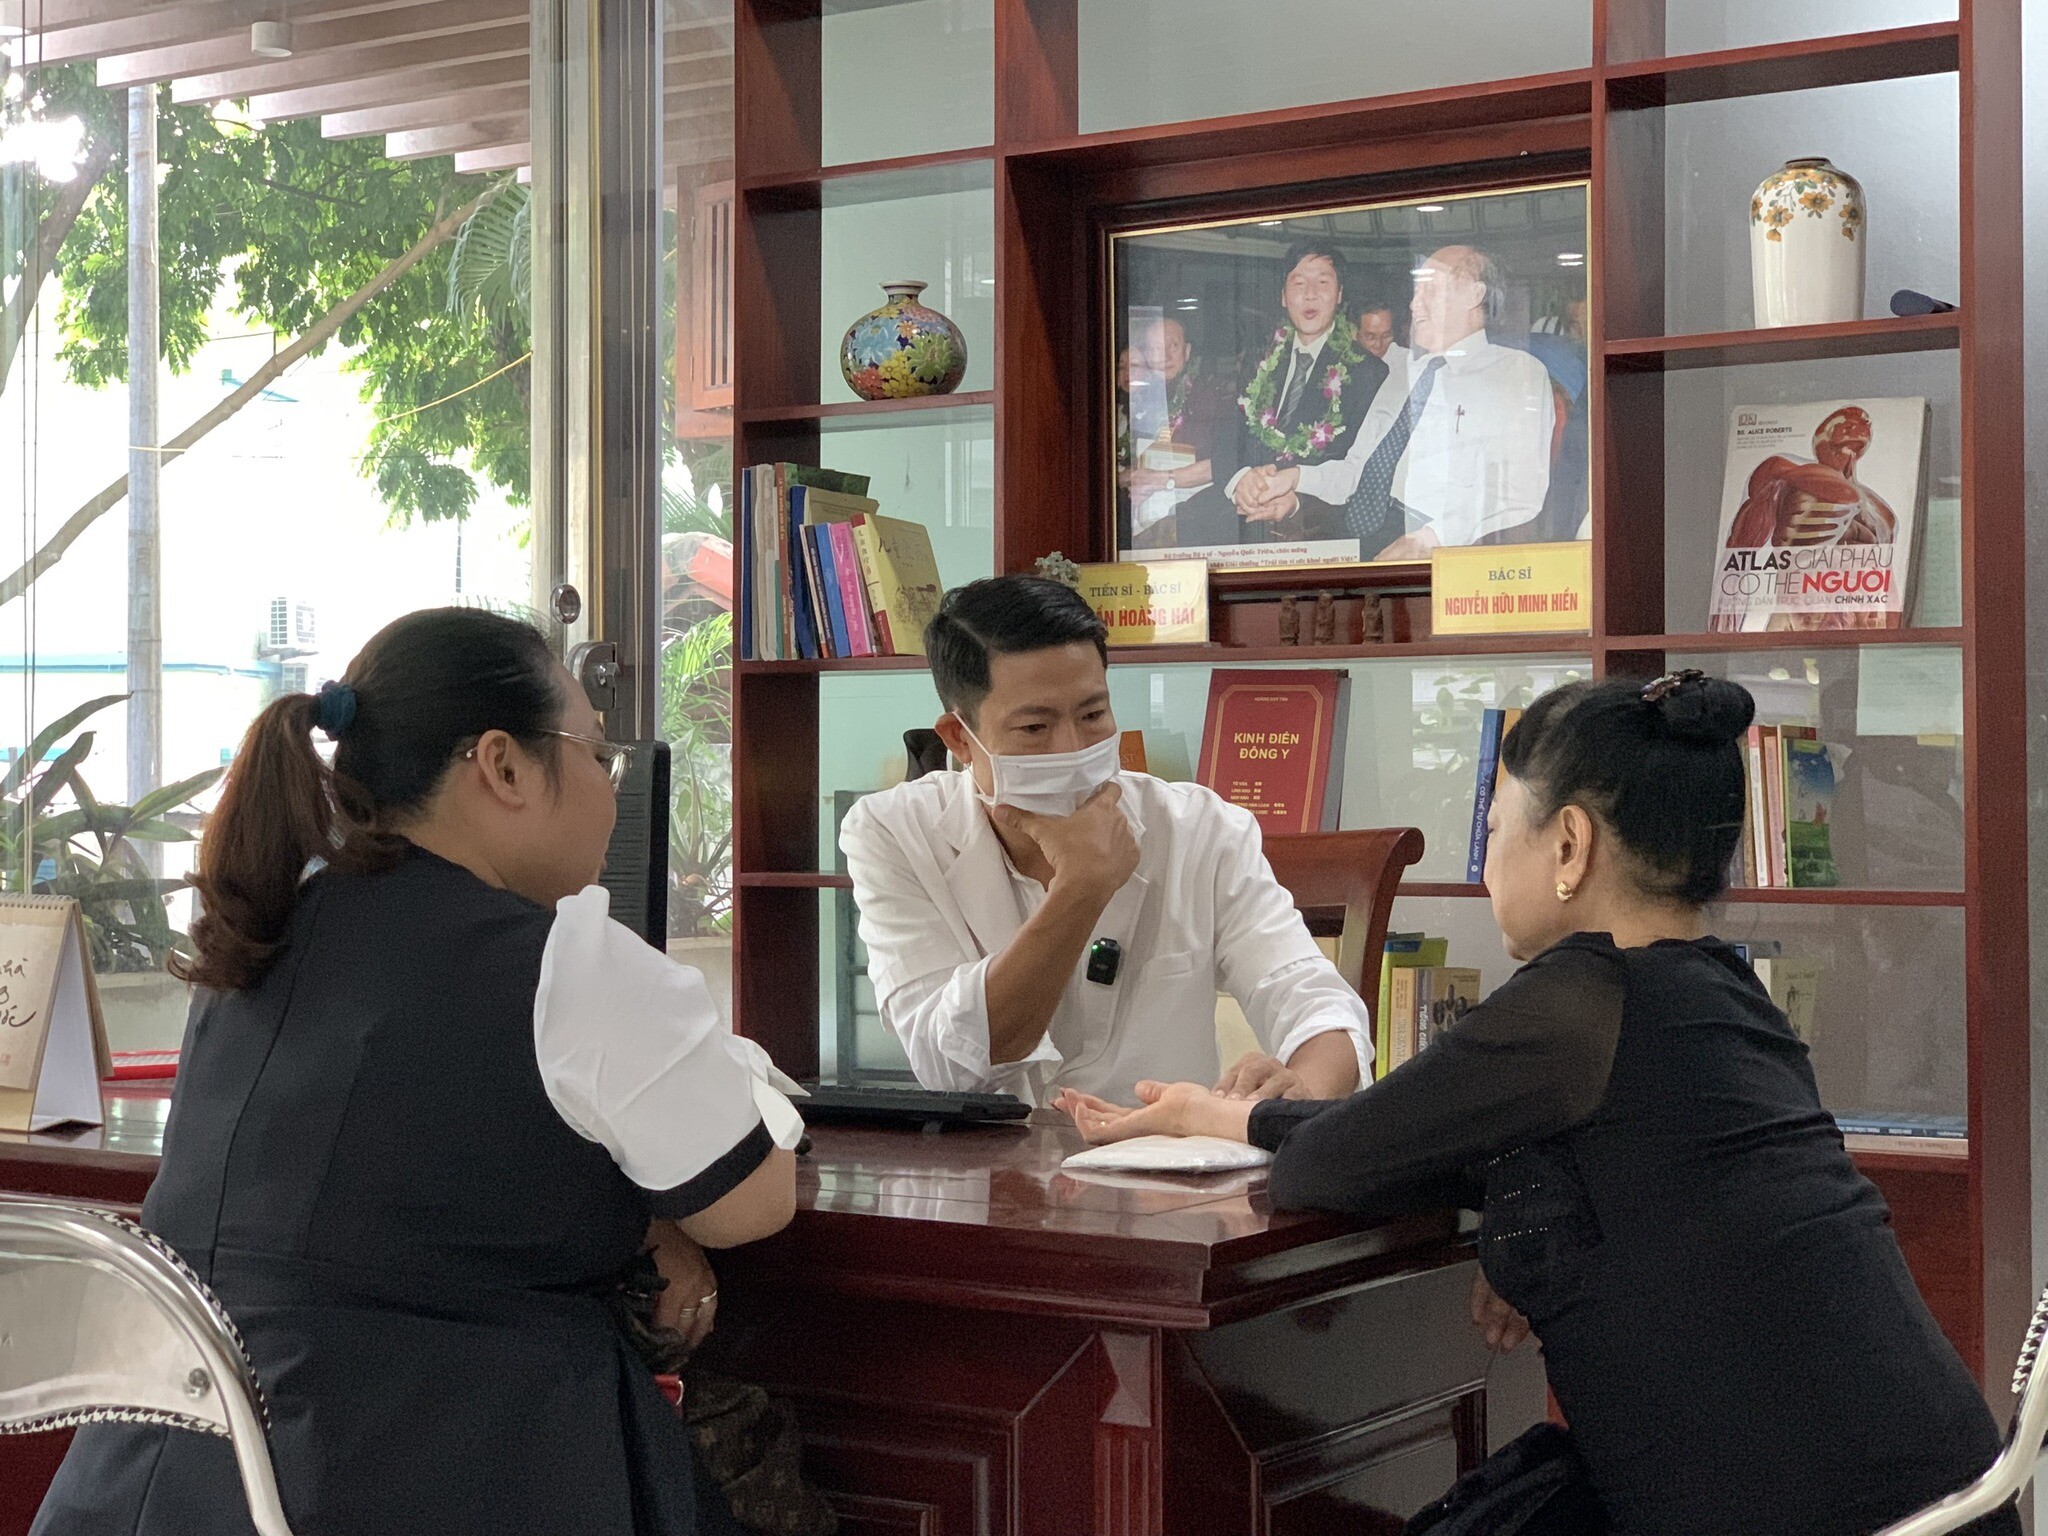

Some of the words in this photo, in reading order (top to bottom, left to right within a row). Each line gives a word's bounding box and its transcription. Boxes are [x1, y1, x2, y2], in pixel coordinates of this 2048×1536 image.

[1724, 550, 1791, 572] ATLAS
[1488, 567, 1516, 581] BÁC
[1089, 582, 1119, 598] TIẾN
[1144, 582, 1168, 595] BÁC
[1445, 589, 1489, 616] NGUYỄN
[1492, 592, 1515, 614] HỮU
[1517, 594, 1548, 613] MINH
[1119, 605, 1167, 627] HOÀNG
[1233, 732, 1265, 744] KINH
[1239, 745, 1278, 760] ĐÔNG
[1282, 748, 1290, 760] Y
